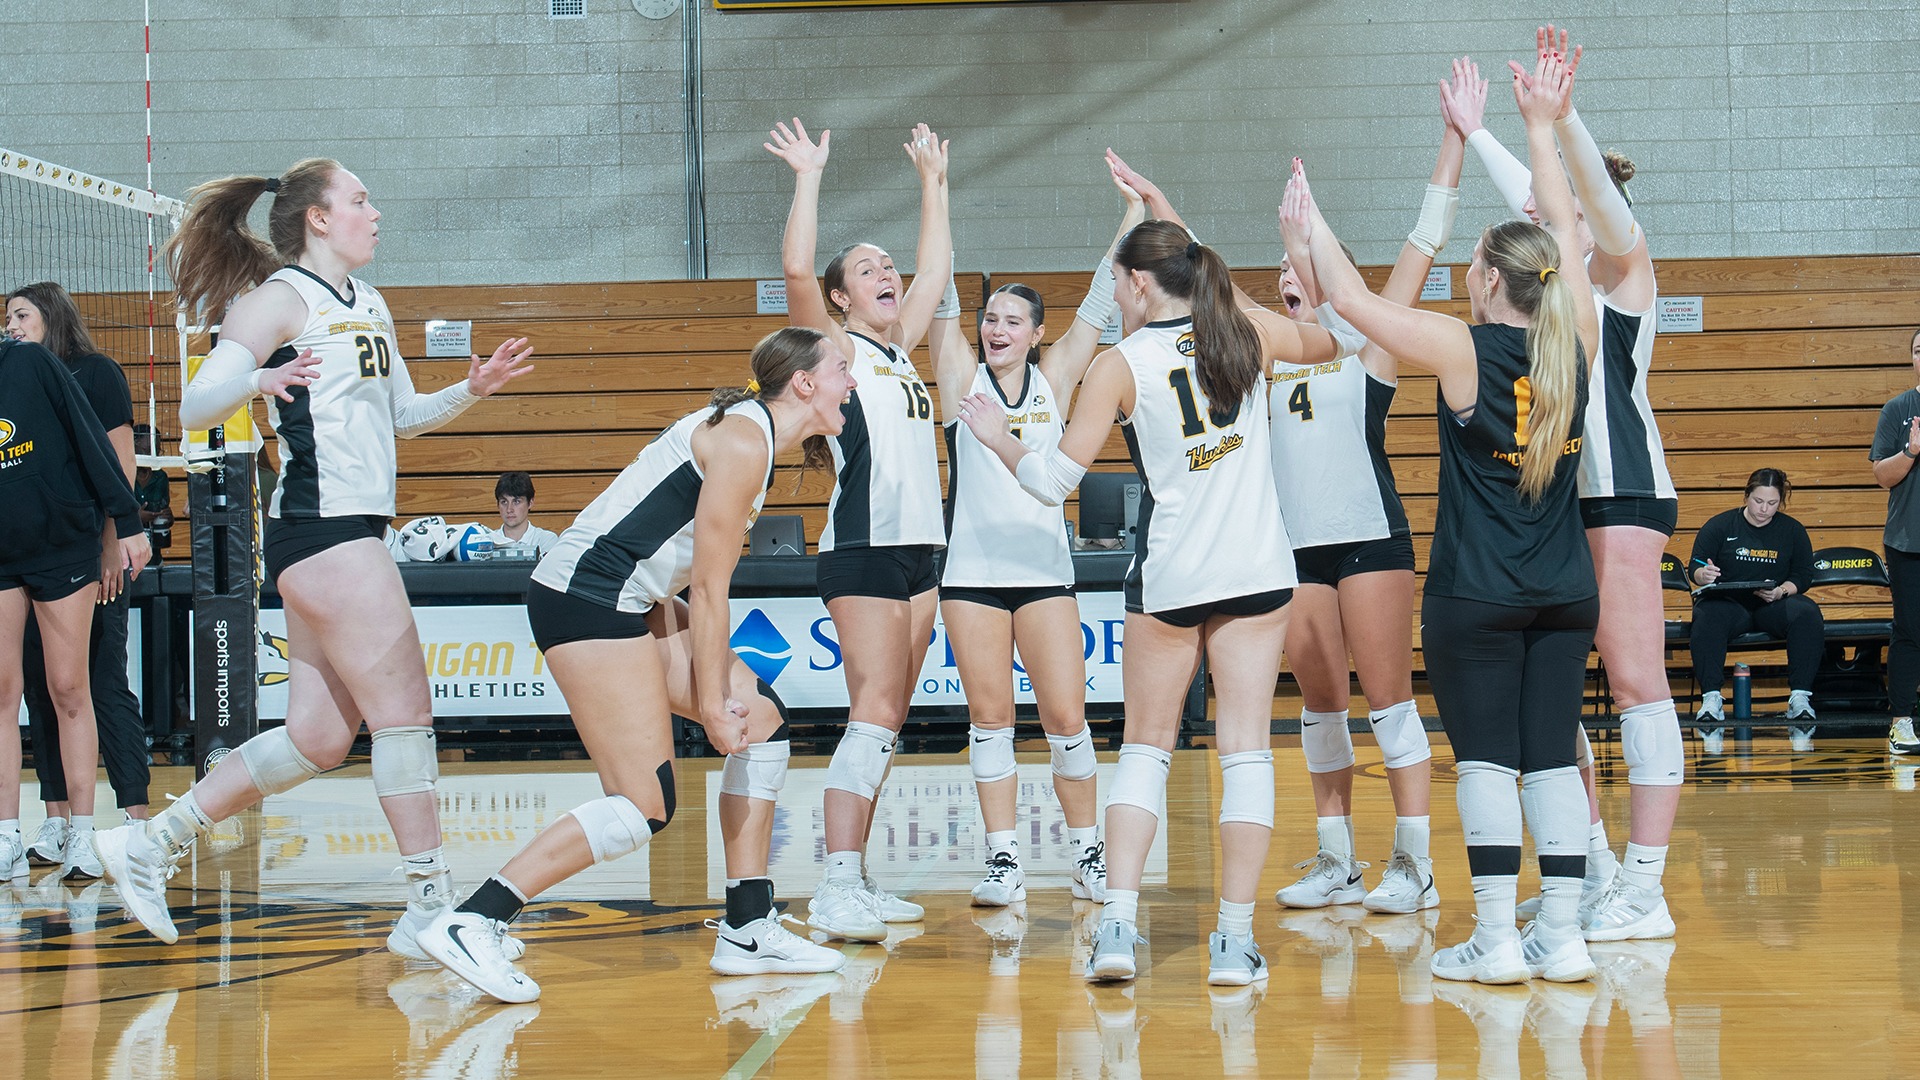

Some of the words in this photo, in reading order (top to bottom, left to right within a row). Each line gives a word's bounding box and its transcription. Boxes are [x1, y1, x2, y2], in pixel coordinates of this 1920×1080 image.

[355, 334, 391, 379] 20
[1180, 342, 1195, 352] GLI
[1314, 361, 1342, 376] TECH
[900, 381, 930, 420] 16
[1288, 381, 1315, 422] 4
[1030, 411, 1051, 423] TECH
[7, 440, 33, 459] TECH
[1185, 433, 1244, 471] Huskies
[0, 457, 23, 469] BALL
[1735, 555, 1776, 564] VOLLEYBALL
[1831, 558, 1873, 569] HUSKIES
[214, 620, 230, 667] sports
[421, 641, 515, 677] IGAN
[215, 669, 231, 727] imports
[434, 682, 545, 698] HLETICS
